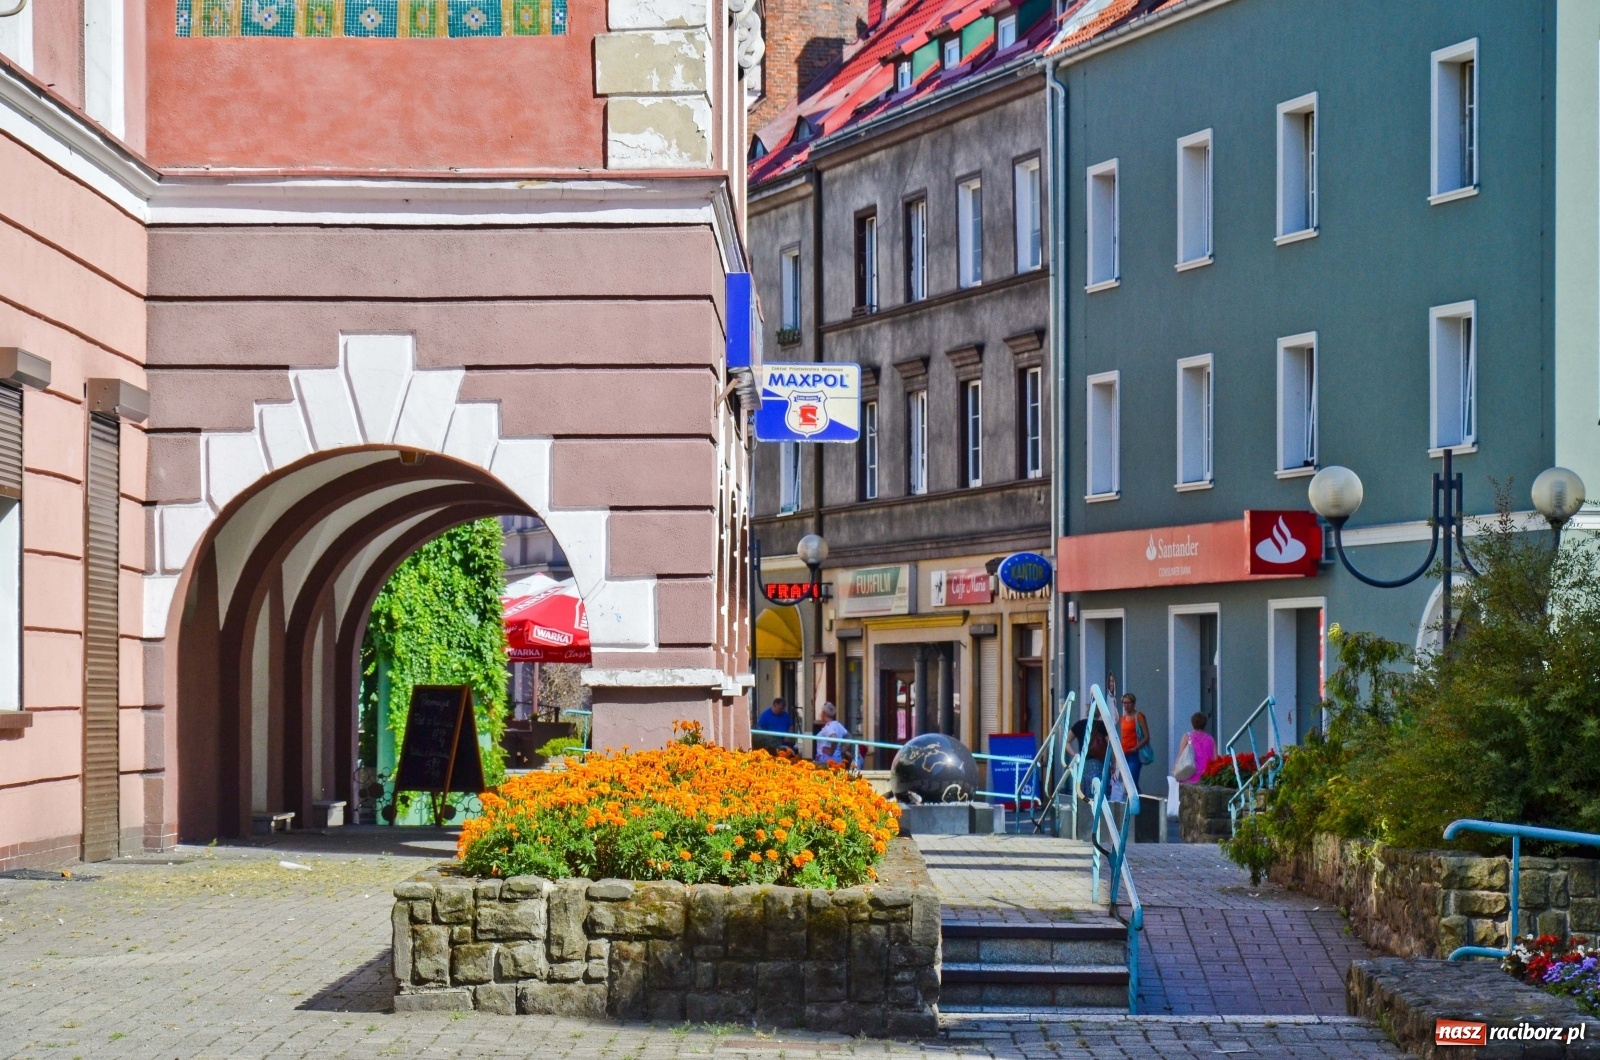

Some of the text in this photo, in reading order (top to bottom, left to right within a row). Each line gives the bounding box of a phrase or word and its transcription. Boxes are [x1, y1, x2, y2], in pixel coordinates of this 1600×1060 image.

[768, 372, 849, 389] MAXPOL
[1158, 534, 1199, 559] Santander
[1011, 562, 1044, 581] KANTOR
[1158, 566, 1192, 577] CONSUMER BANK
[856, 573, 891, 594] FUJIFILM
[536, 628, 570, 643] WARKA
[509, 648, 540, 656] WARKA
